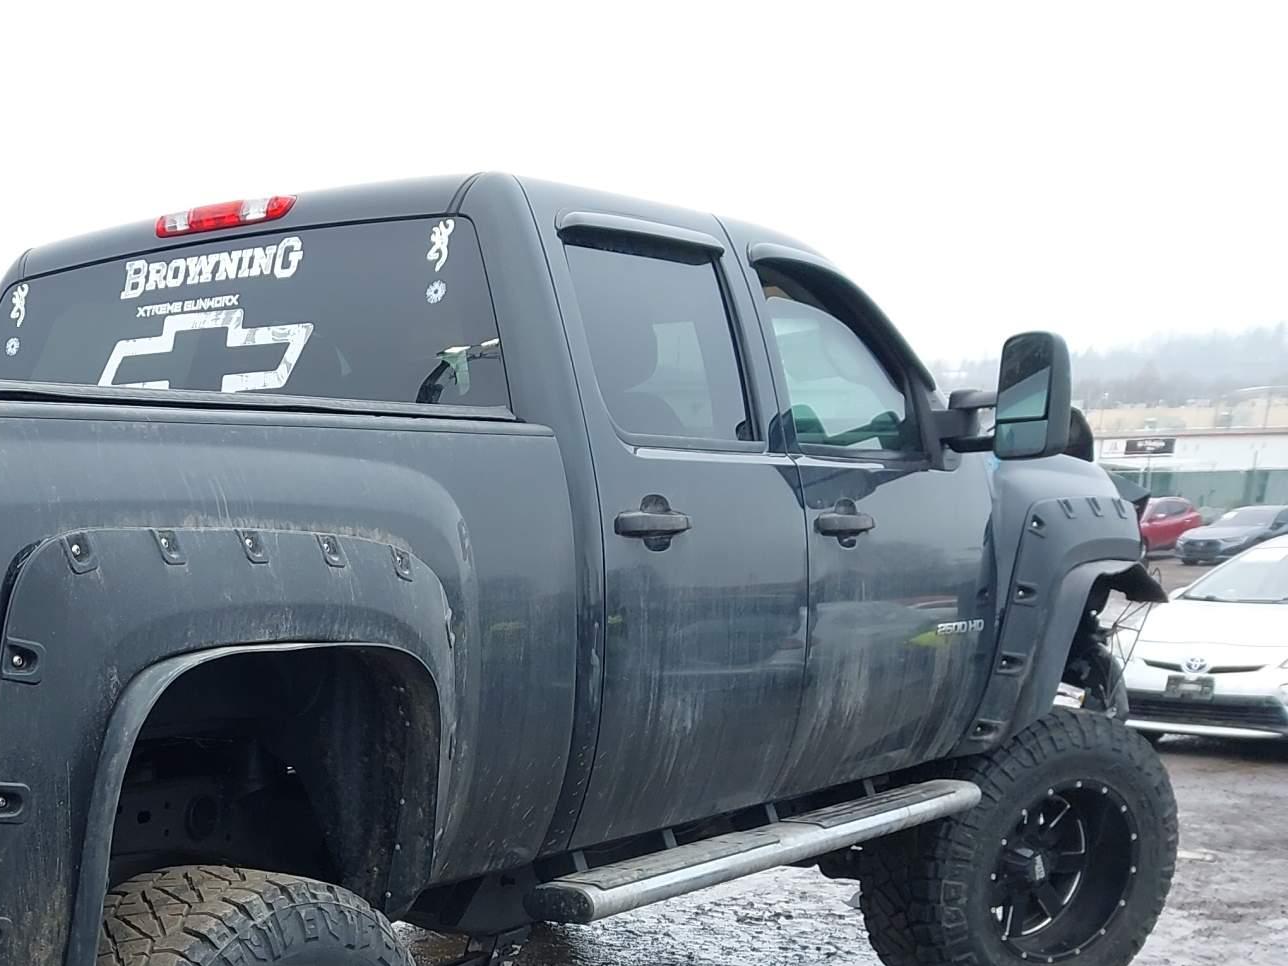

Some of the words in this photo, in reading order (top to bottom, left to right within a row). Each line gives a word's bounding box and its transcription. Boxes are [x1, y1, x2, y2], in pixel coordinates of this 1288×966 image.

[120, 236, 304, 300] BROWNING
[136, 301, 183, 318] XTREME
[183, 294, 241, 312] GUNWORX
[937, 620, 968, 635] 2500
[968, 618, 985, 633] HD
